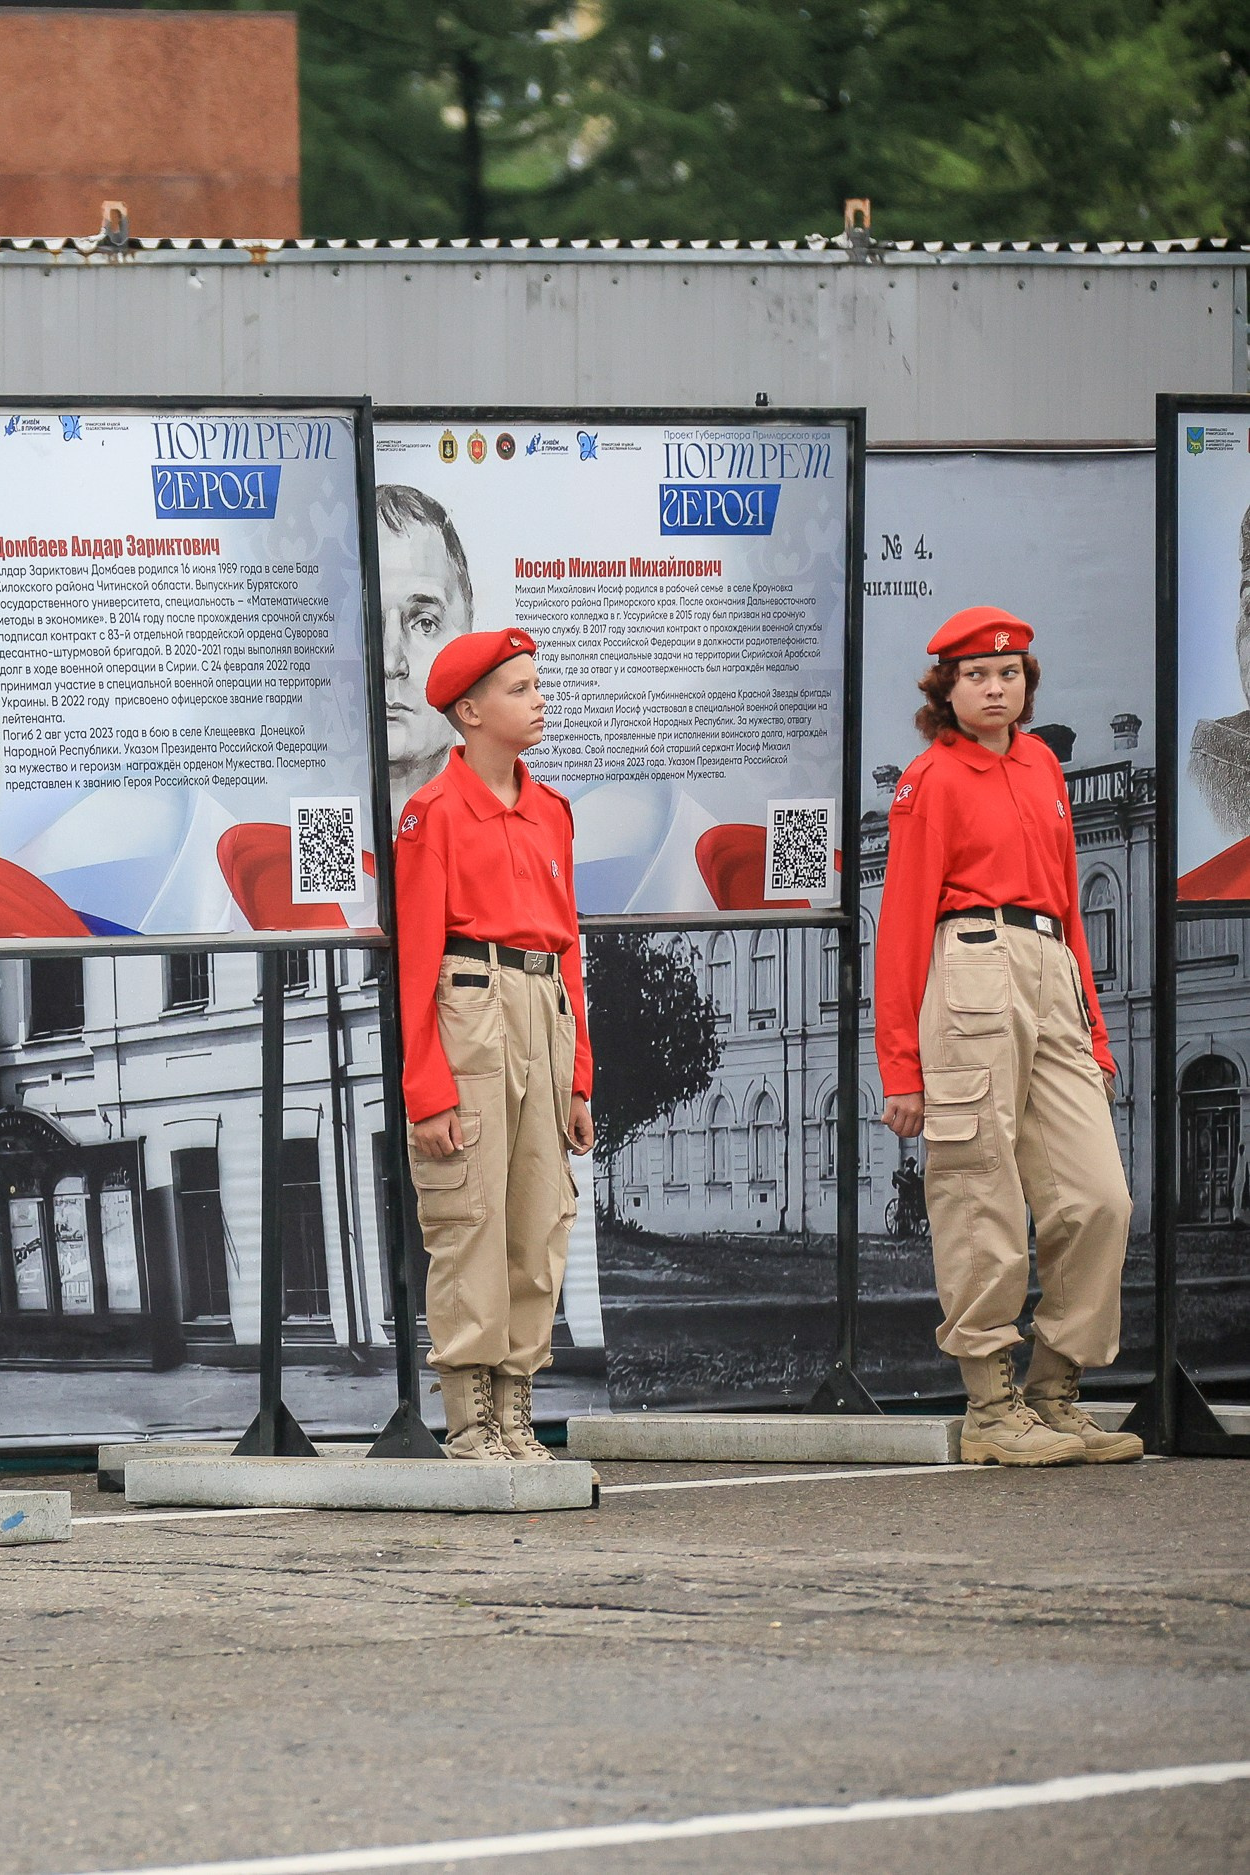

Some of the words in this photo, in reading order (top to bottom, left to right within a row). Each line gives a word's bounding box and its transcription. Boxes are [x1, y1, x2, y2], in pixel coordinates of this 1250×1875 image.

[151, 422, 337, 460] ПОРТРЕТ
[664, 431, 693, 440] Проект
[696, 430, 750, 441] Губернатора
[753, 430, 810, 441] Приморского
[812, 432, 831, 441] края
[663, 443, 835, 479] ПОРТРЕТ
[156, 467, 268, 510] ГЕРОЯ
[663, 485, 766, 528] ГЕРОЯ
[72, 536, 123, 560] Алдар
[126, 535, 220, 558] Зариктович
[881, 533, 903, 561] №
[914, 533, 933, 559] 4.
[29, 564, 89, 578] Зариктович
[91, 564, 136, 577] Домбаев
[138, 566, 179, 577] родился
[180, 563, 190, 574] 16
[192, 565, 216, 574] июня
[218, 562, 238, 574] 1989
[240, 565, 262, 576] года
[265, 565, 270, 574] в
[272, 565, 294, 574] селе
[296, 562, 319, 575] Бада
[515, 558, 565, 580] Иосиф
[569, 558, 626, 578] Михаил
[630, 556, 722, 577] Михайлович
[56, 581, 95, 594] района
[96, 580, 149, 591] Читинской
[151, 580, 194, 591] области.
[195, 579, 244, 593] Выпускник
[247, 579, 298, 593] Бурятского
[515, 598, 570, 610] Уссурийского
[571, 598, 602, 609] района
[604, 597, 656, 609] Приморского
[657, 599, 678, 609] края.
[680, 596, 704, 606] После
[705, 598, 746, 606] окончания
[746, 596, 816, 607] Дальневосточного
[38, 616, 43, 625] в
[46, 616, 107, 625] экономике».
[110, 613, 117, 624] В
[118, 612, 141, 624] 2014
[143, 615, 164, 626] году
[166, 614, 196, 623] после
[198, 614, 260, 626] прохождения
[262, 612, 300, 625] срочной
[303, 612, 335, 625] службы
[0, 646, 111, 660] десантно-штурмовой
[113, 645, 163, 659] бригадой.
[166, 644, 172, 656] В
[174, 644, 221, 656] 2020-2021
[224, 646, 246, 657] годы
[248, 646, 292, 655] выполнял
[294, 644, 334, 654] воинский
[542, 654, 559, 663] году
[560, 653, 598, 661] выполнял
[600, 652, 652, 662] специальные
[654, 652, 682, 661] задачи
[683, 652, 693, 660] на
[695, 652, 740, 661] территории
[742, 649, 783, 661] Сирийской
[784, 649, 820, 660] Арабской
